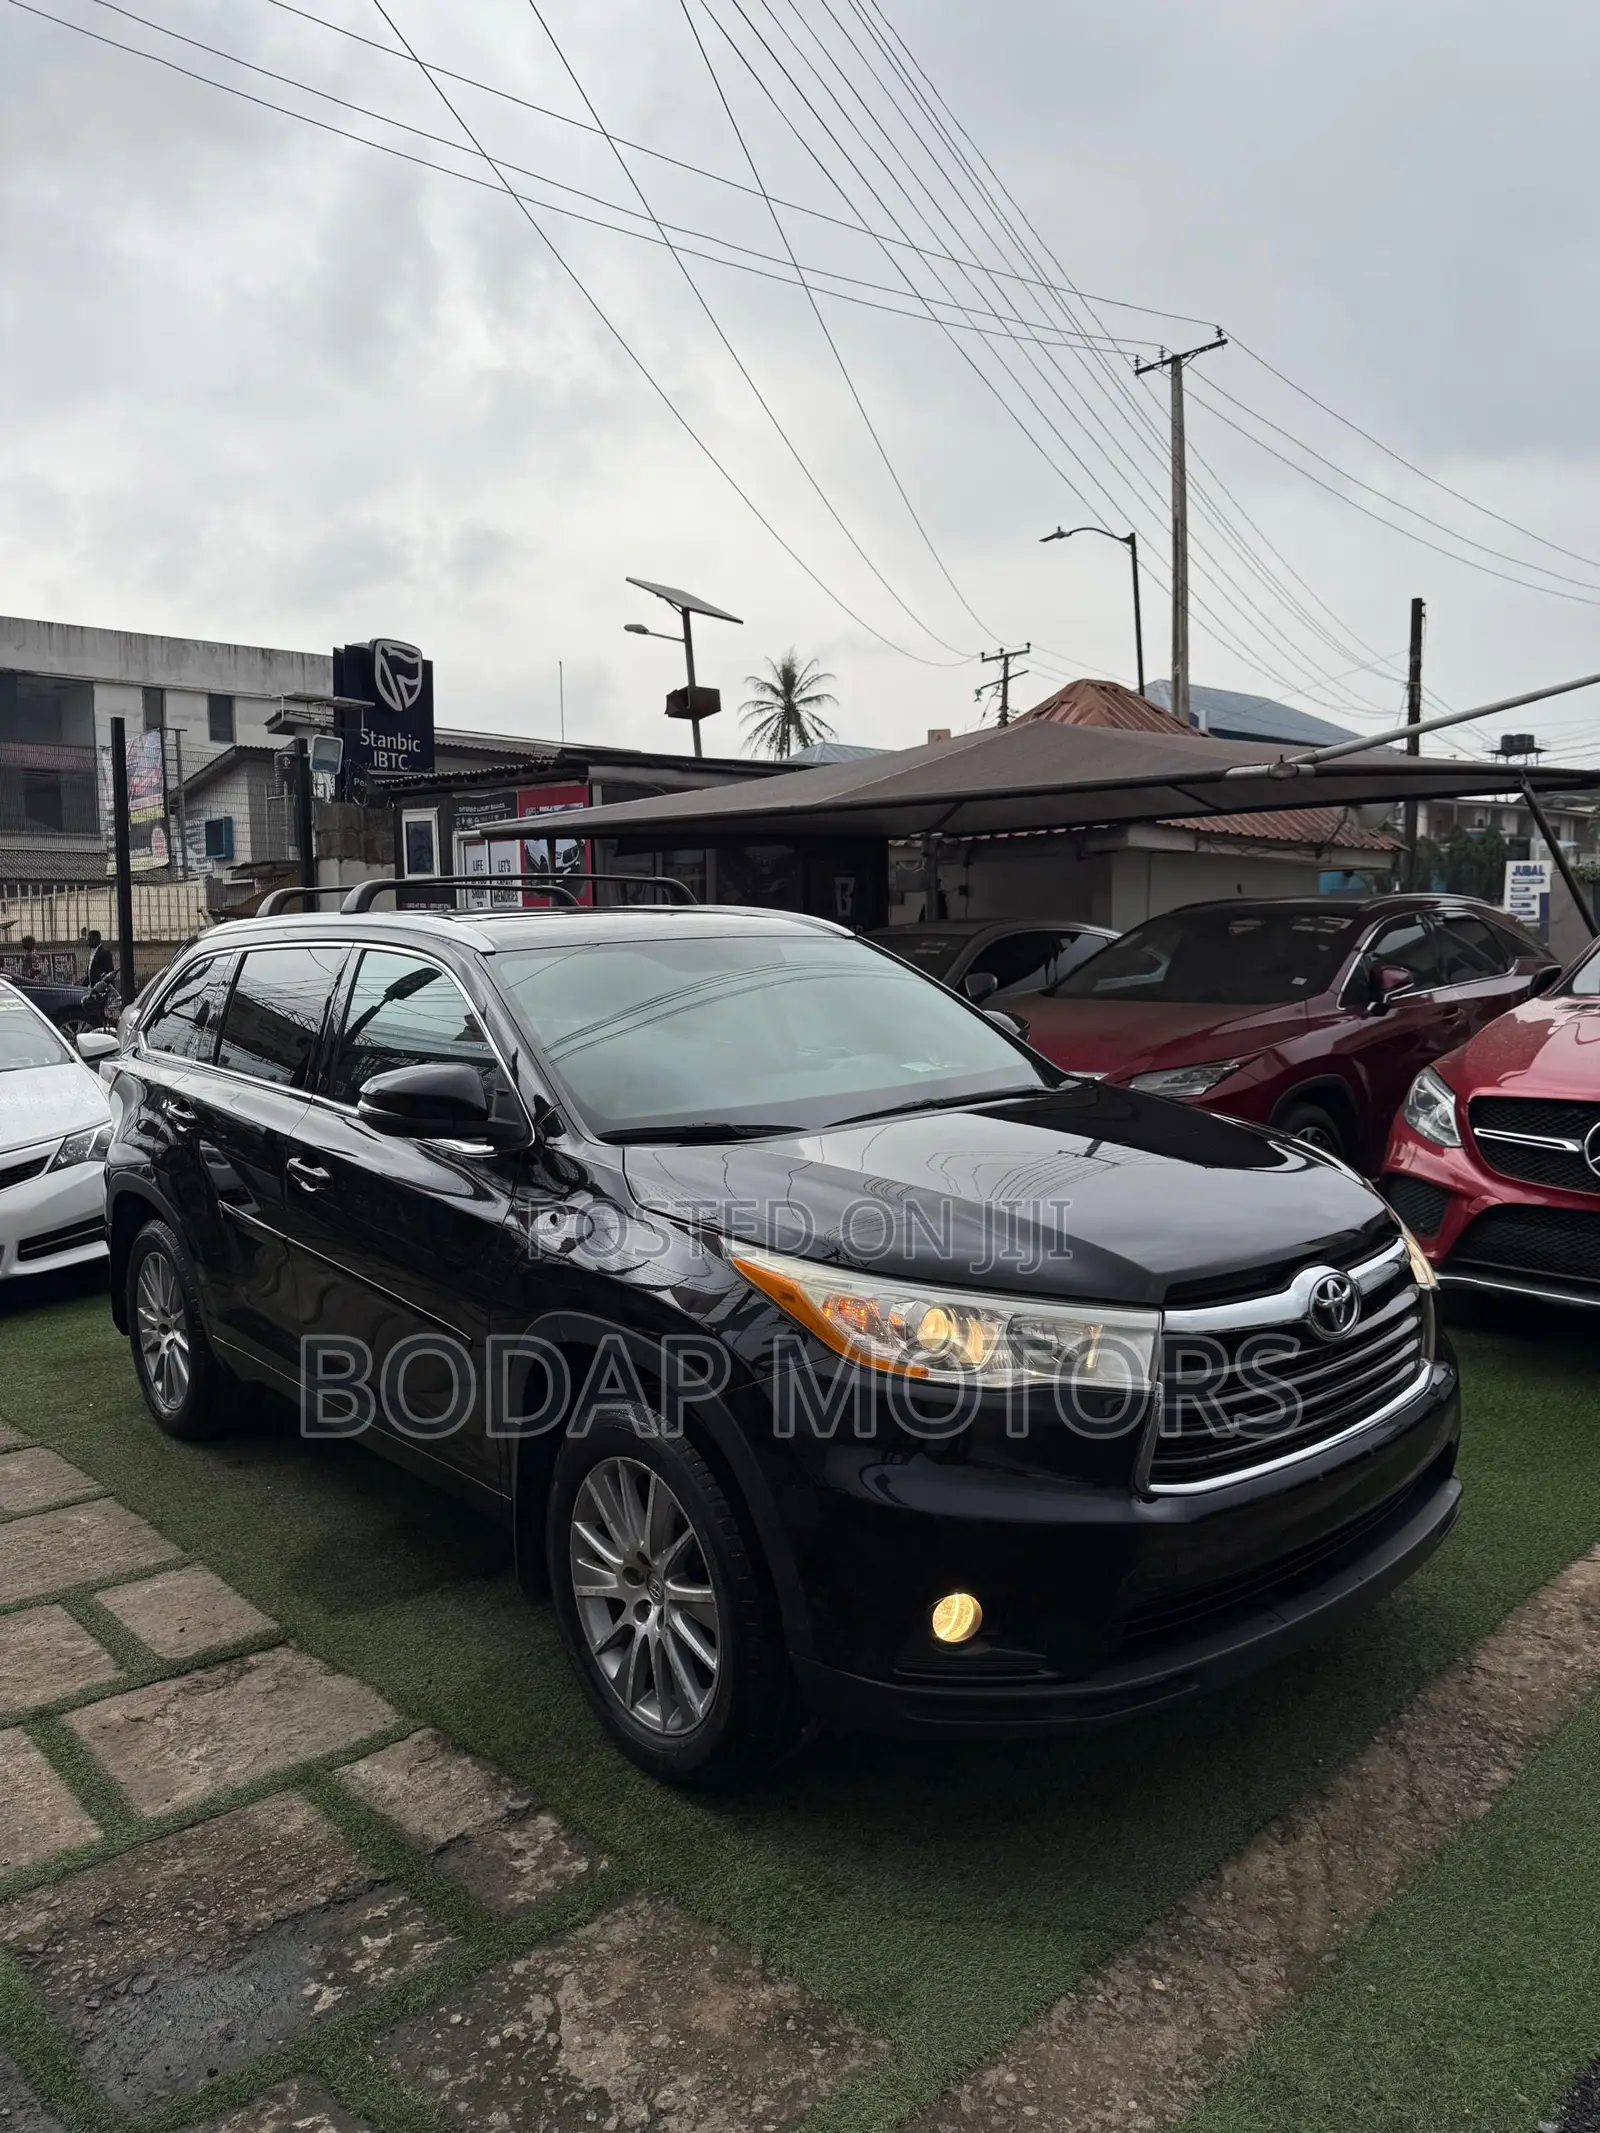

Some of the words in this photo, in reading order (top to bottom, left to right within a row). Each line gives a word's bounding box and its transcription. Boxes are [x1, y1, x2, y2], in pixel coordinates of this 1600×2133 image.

[360, 728, 421, 752] Stanbic
[373, 750, 408, 770] IBTC
[472, 859, 484, 872] LIFE
[497, 858, 512, 873] LET'S
